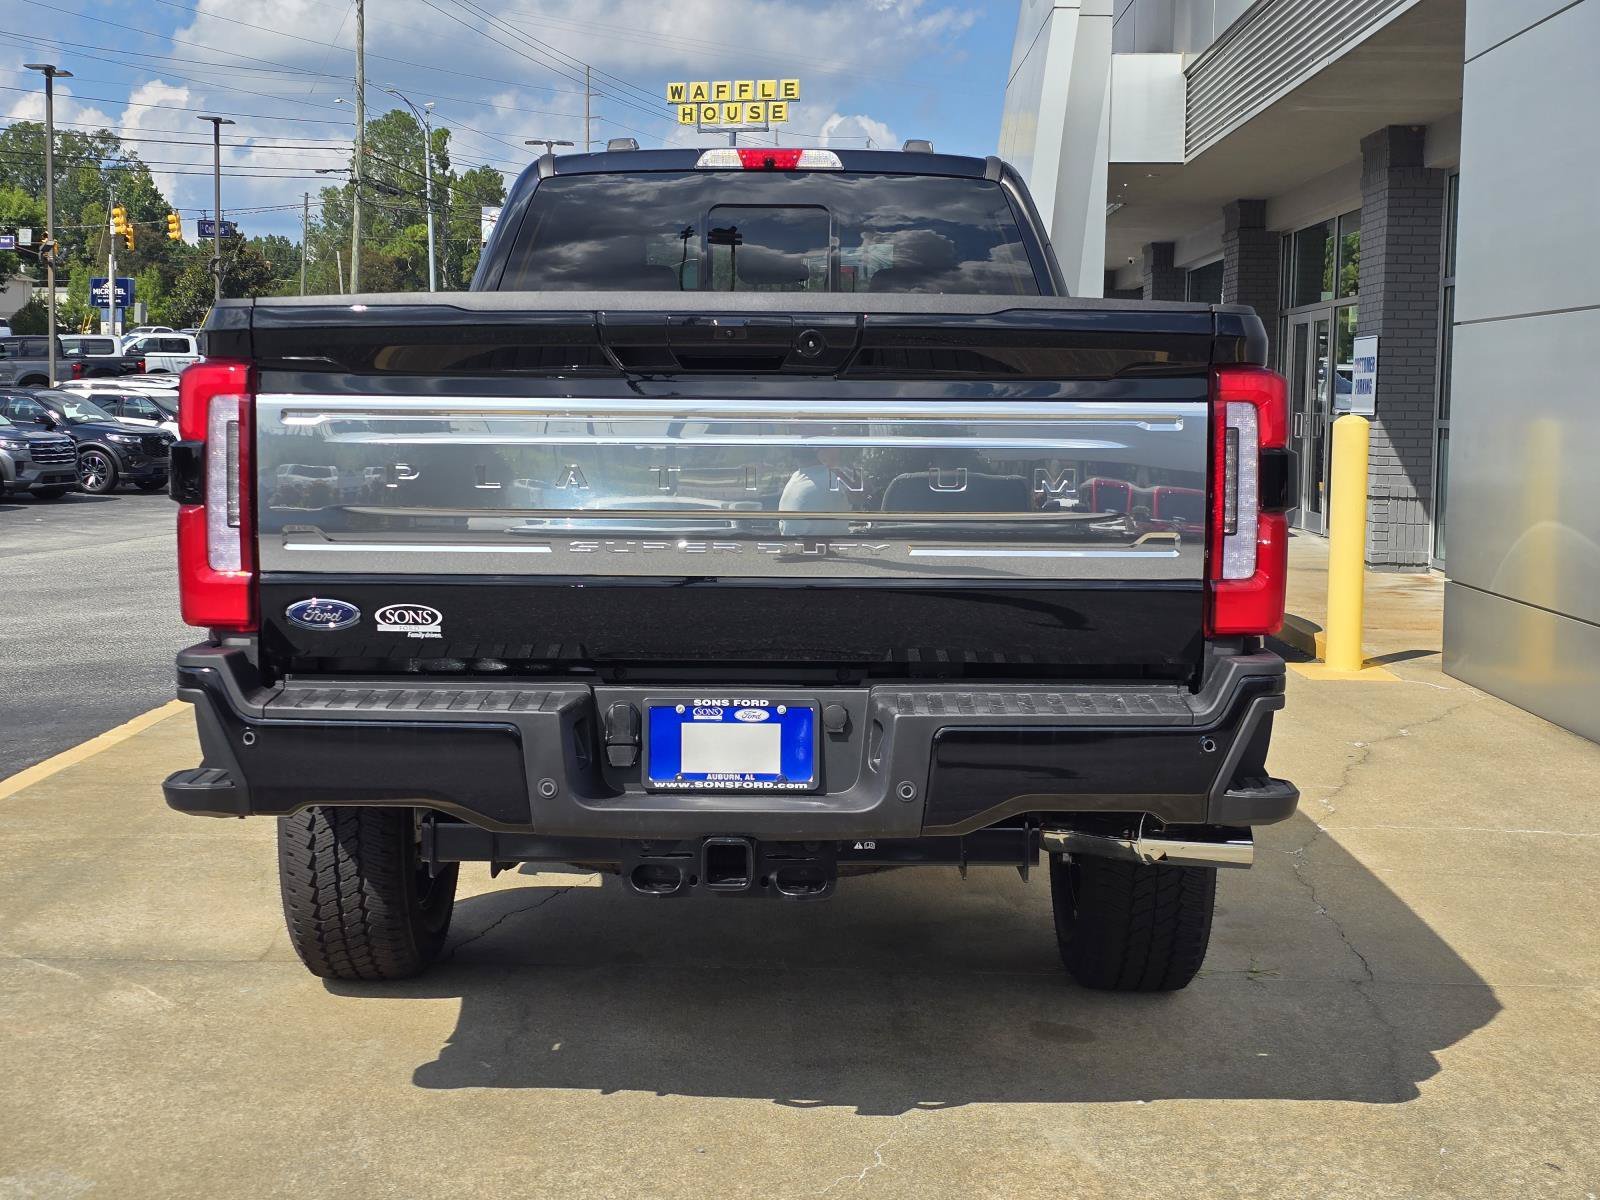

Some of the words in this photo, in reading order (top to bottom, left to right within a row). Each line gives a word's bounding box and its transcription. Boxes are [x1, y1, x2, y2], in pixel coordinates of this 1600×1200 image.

[670, 82, 795, 100] WAFFLE
[682, 104, 783, 121] HOUSE
[386, 464, 1077, 493] PLATINUM
[569, 541, 743, 554] SUPER
[757, 541, 890, 555] DUTY
[302, 605, 342, 621] Ford
[385, 610, 432, 624] SONS
[693, 699, 730, 707] SONS
[733, 699, 770, 707] FORD
[696, 708, 720, 716] SONS
[741, 710, 763, 720] Ford
[706, 774, 743, 782] AUBURN,
[653, 781, 808, 790] www.SONSFORD.com
